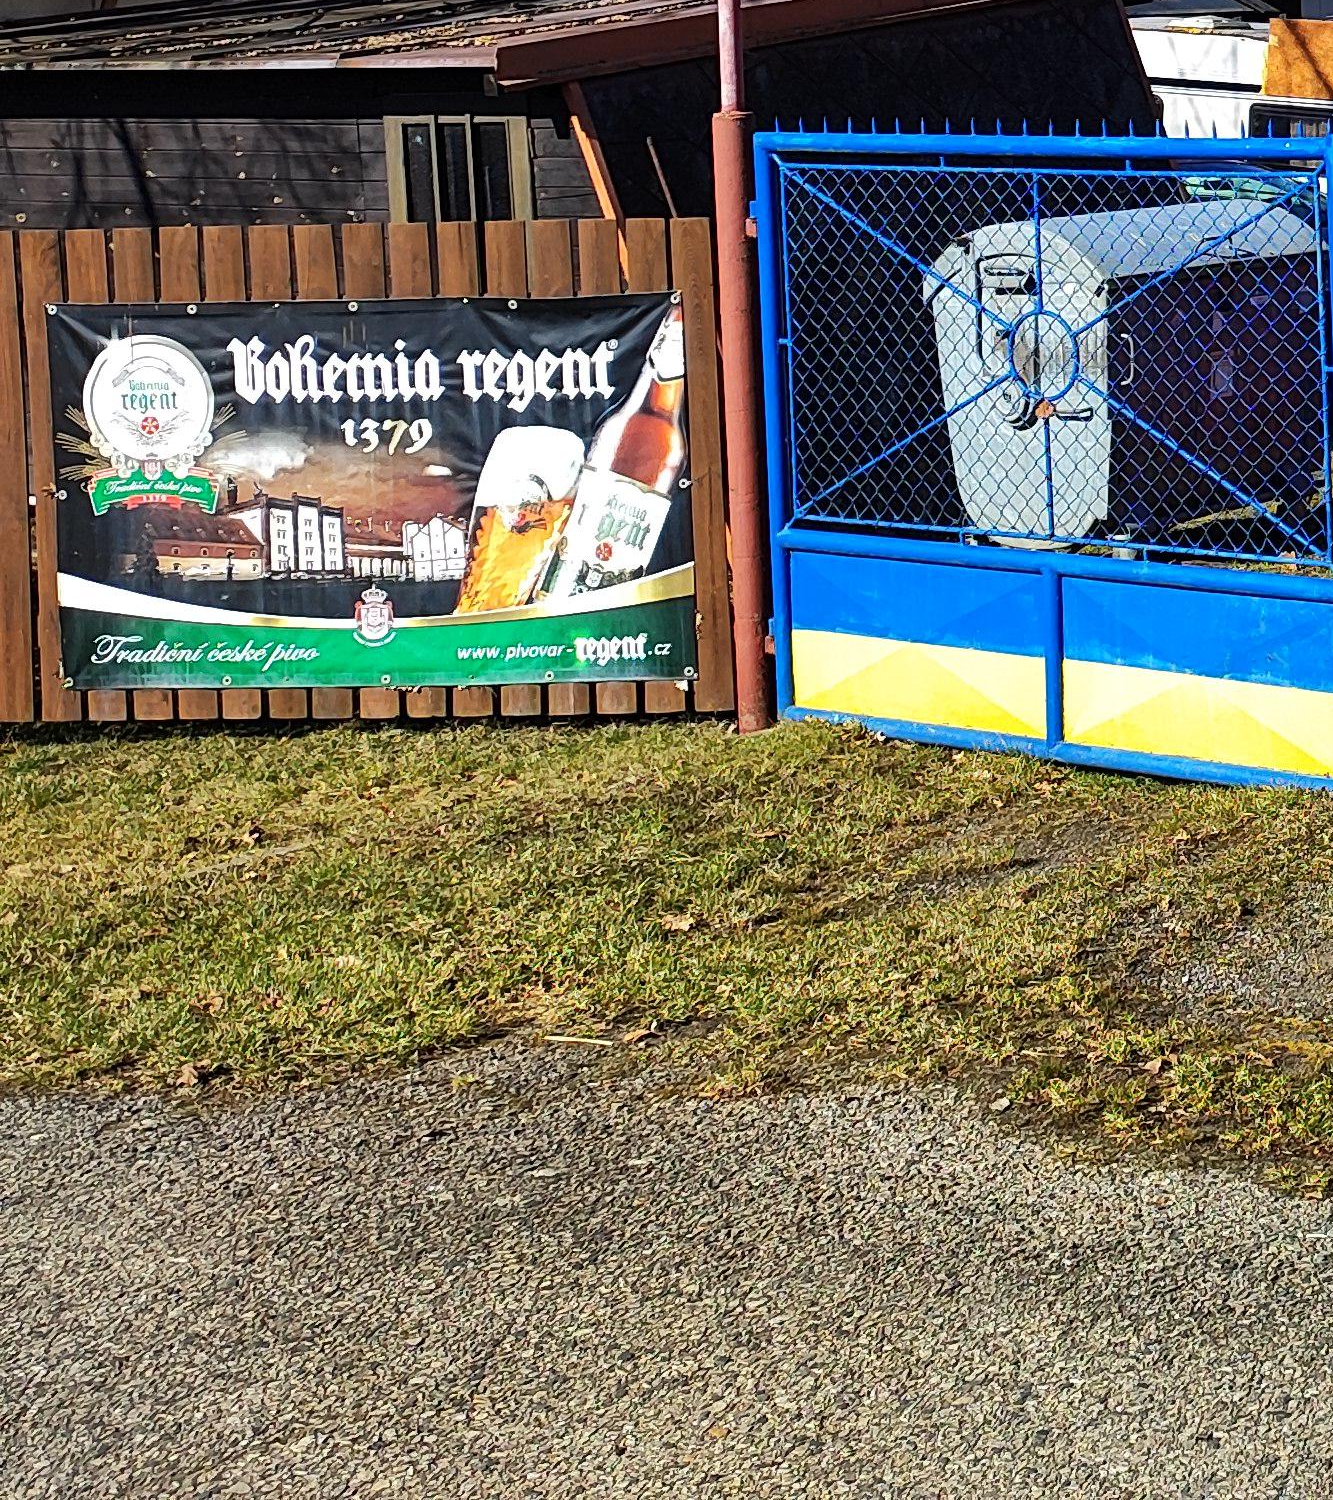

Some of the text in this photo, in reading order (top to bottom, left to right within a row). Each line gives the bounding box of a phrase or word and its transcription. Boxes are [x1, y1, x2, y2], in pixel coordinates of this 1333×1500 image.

[227, 335, 446, 404] Bohemia
[121, 391, 179, 414] regent
[340, 417, 434, 457] 1379
[91, 634, 320, 672] Tradiční české pivo
